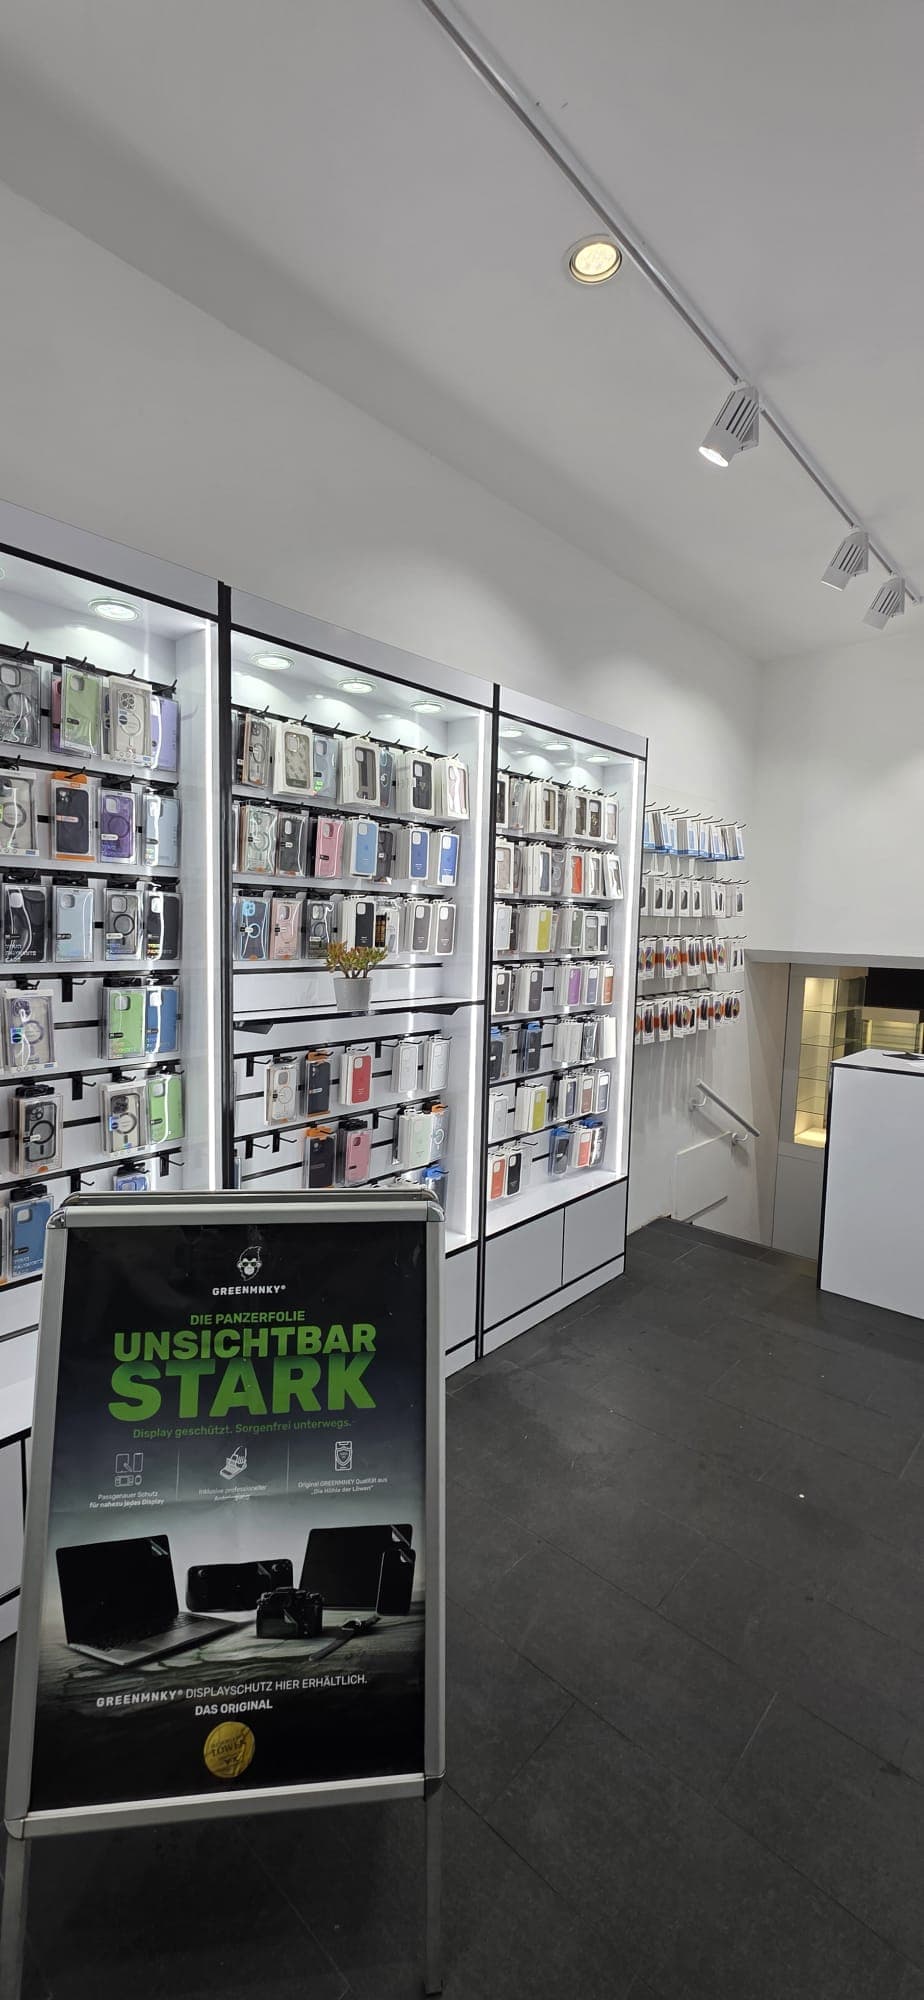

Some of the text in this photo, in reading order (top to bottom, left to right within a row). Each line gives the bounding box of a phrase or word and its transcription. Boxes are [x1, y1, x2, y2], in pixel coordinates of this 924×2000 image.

[190, 1310, 306, 1326] DIE PANZERFOLIE
[114, 1323, 377, 1362] UNSICHTBAR
[108, 1350, 377, 1422] STARK
[133, 1419, 352, 1440] Display geschützt. Sorgenfrei unterwegs.
[142, 1498, 165, 1506] Display
[185, 1682, 273, 1699] DISPLAYSCHUTZ
[275, 1678, 300, 1691] HIER
[302, 1673, 368, 1689] ERHÄLTLICH.
[195, 1699, 273, 1716] DAS ORIGINAL
